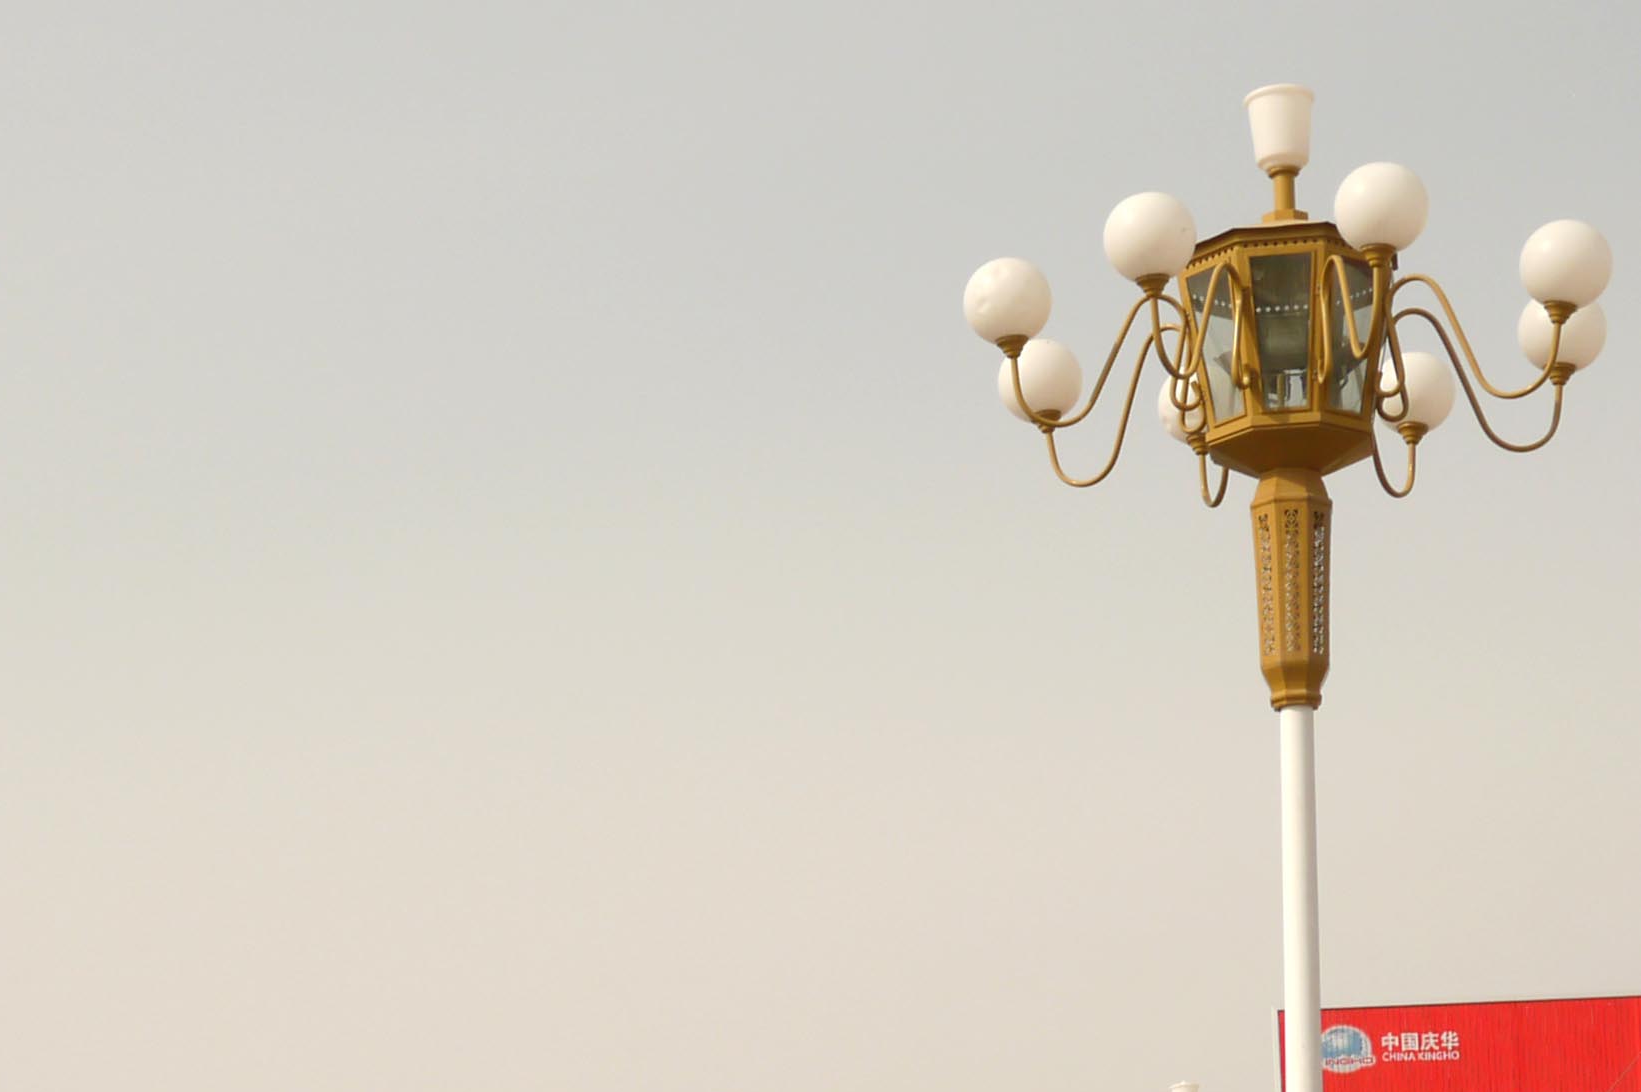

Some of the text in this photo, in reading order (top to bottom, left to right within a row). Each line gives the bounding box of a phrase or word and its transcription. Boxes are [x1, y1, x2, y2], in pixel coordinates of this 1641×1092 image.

[1381, 1031, 1459, 1051] 中国庆华
[1382, 1050, 1460, 1062] CHINA KINGHO
